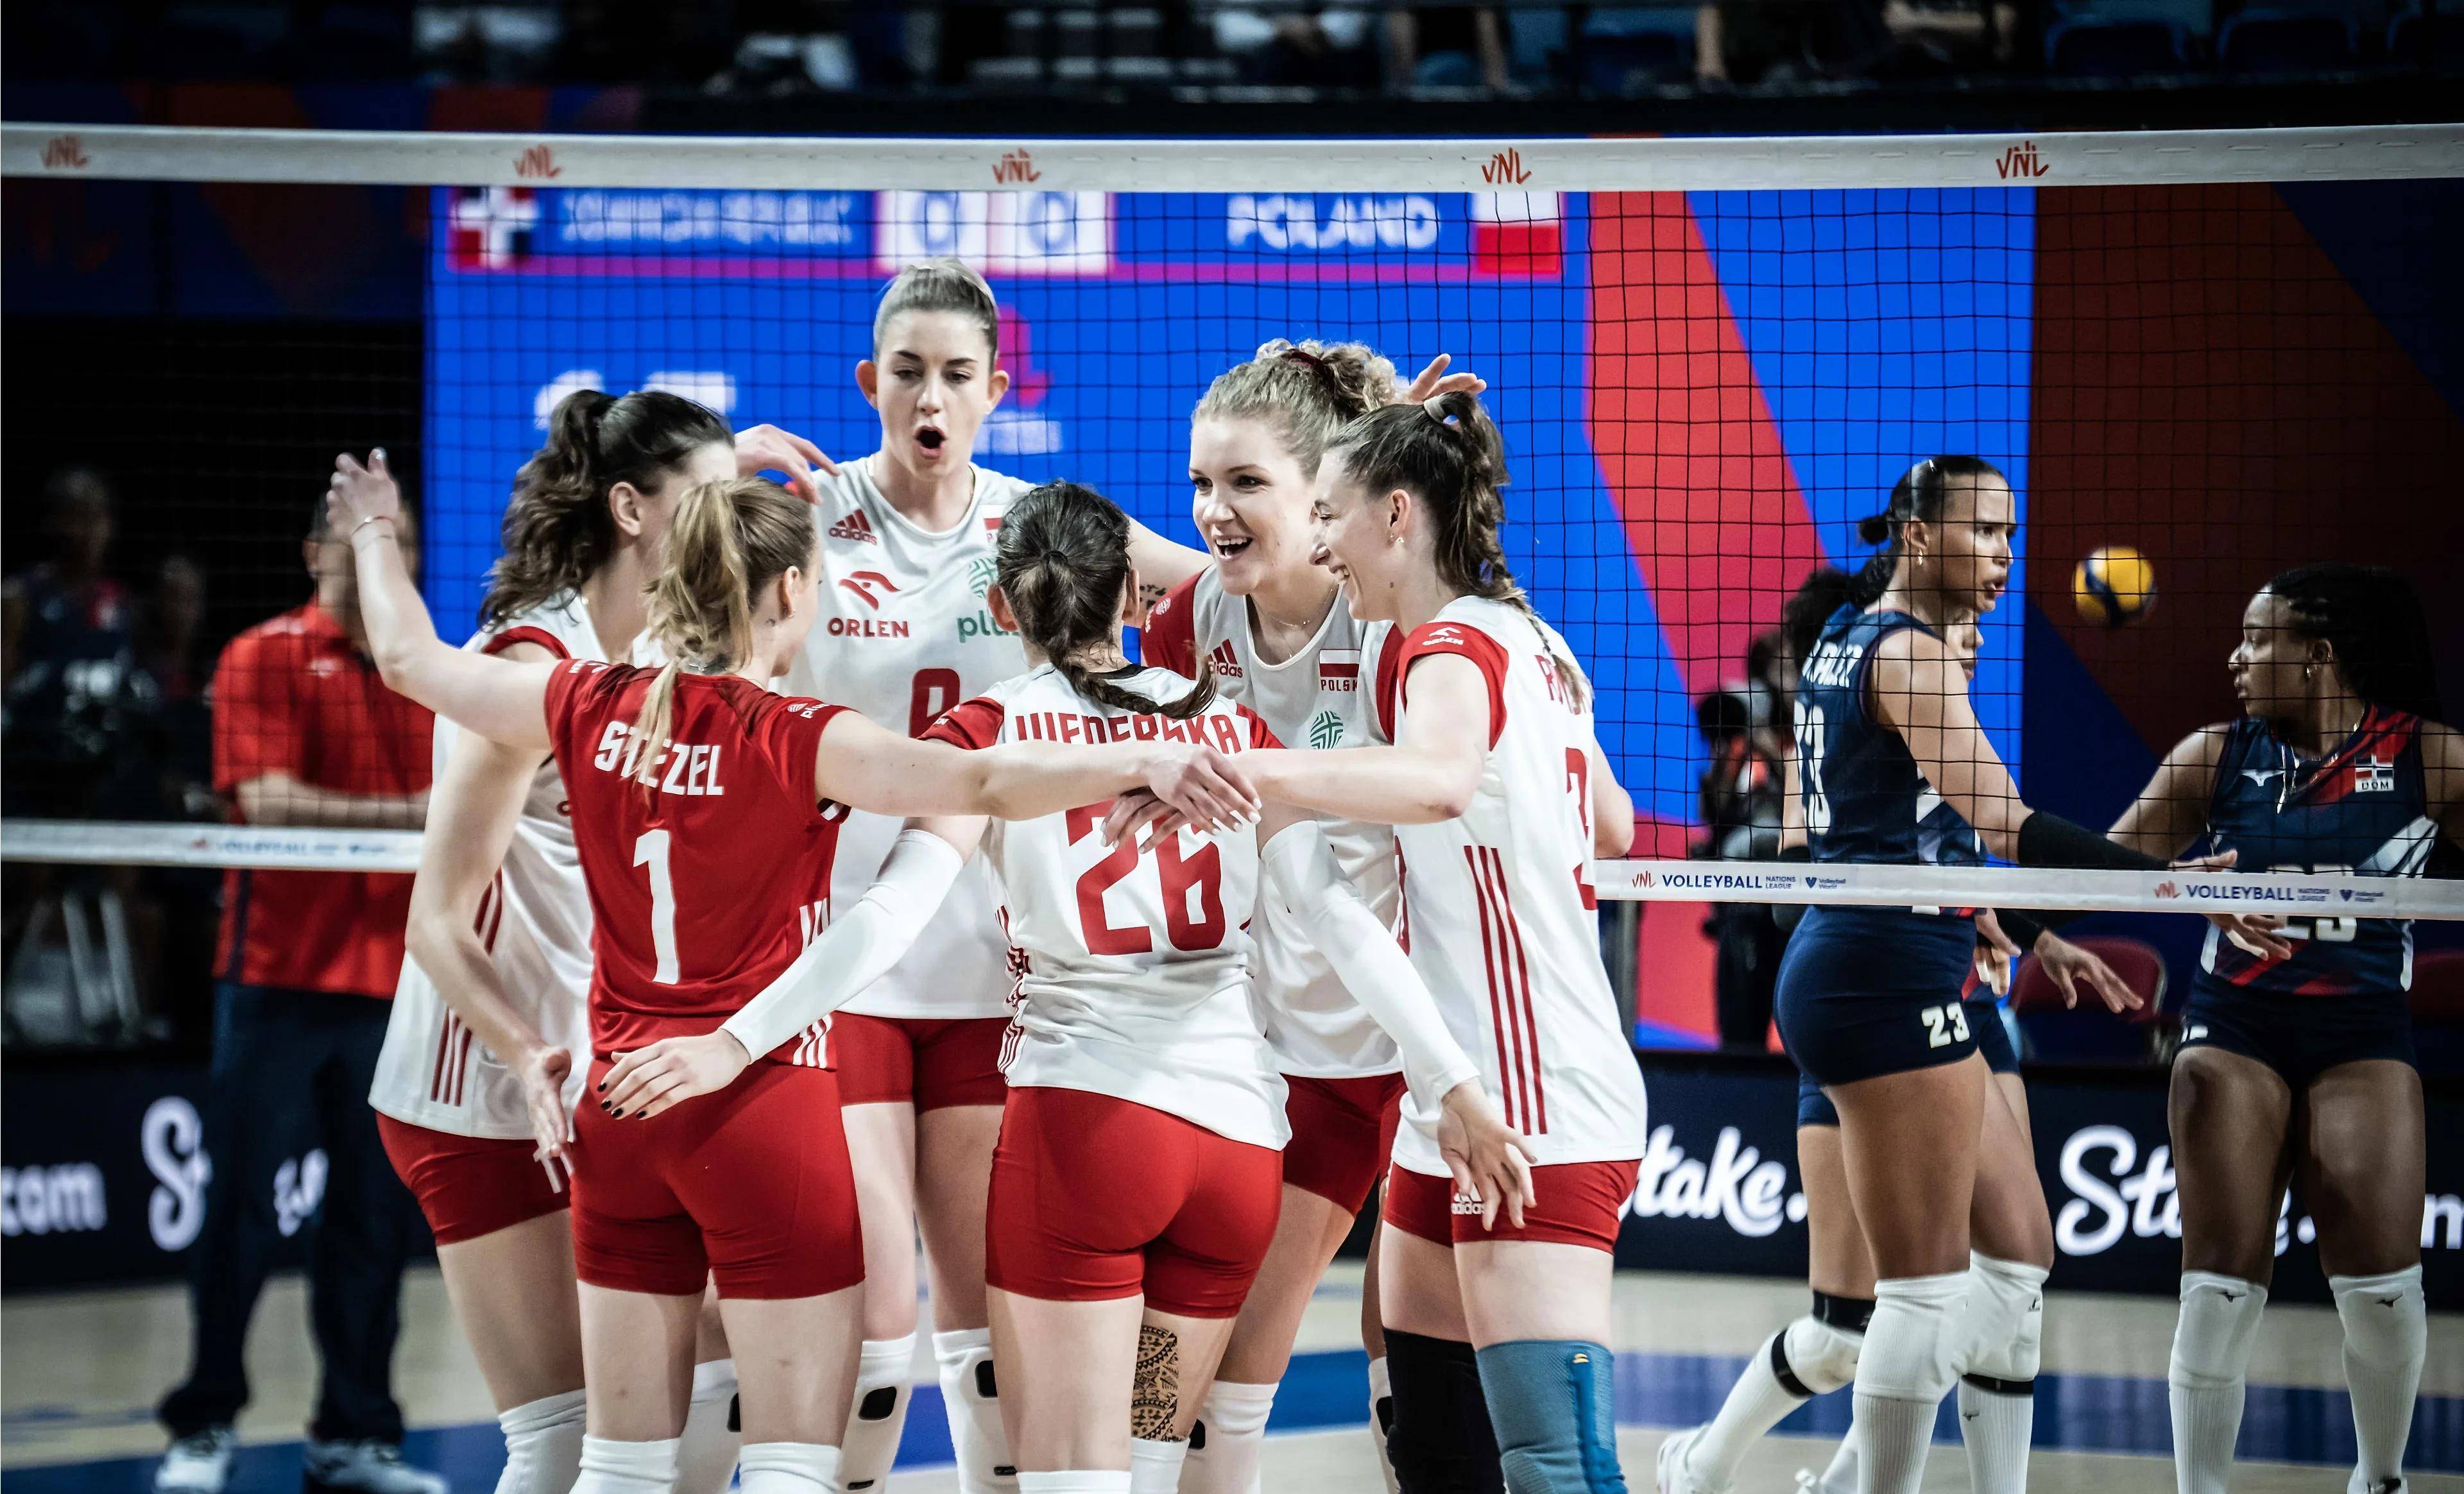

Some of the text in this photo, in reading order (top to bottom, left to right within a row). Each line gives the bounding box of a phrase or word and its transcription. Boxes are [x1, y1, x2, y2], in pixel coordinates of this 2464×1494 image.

[513, 144, 562, 178] VNL
[992, 147, 1041, 184] VNL
[1481, 147, 1532, 184] VNL
[1996, 140, 2049, 179] VNL
[1227, 194, 1441, 249] POLAND
[828, 527, 878, 545] adidas
[827, 618, 909, 638] ORLEN
[2361, 780, 2390, 790] DOM
[1065, 798, 1227, 956] 26
[1632, 870, 1656, 888] VNL
[1663, 874, 1762, 889] VOLLEYBALL
[2153, 881, 2180, 899] VNL
[2186, 885, 2295, 901] VOLLEYBALL
[633, 829, 681, 985] 1
[1921, 1001, 1970, 1048] 23
